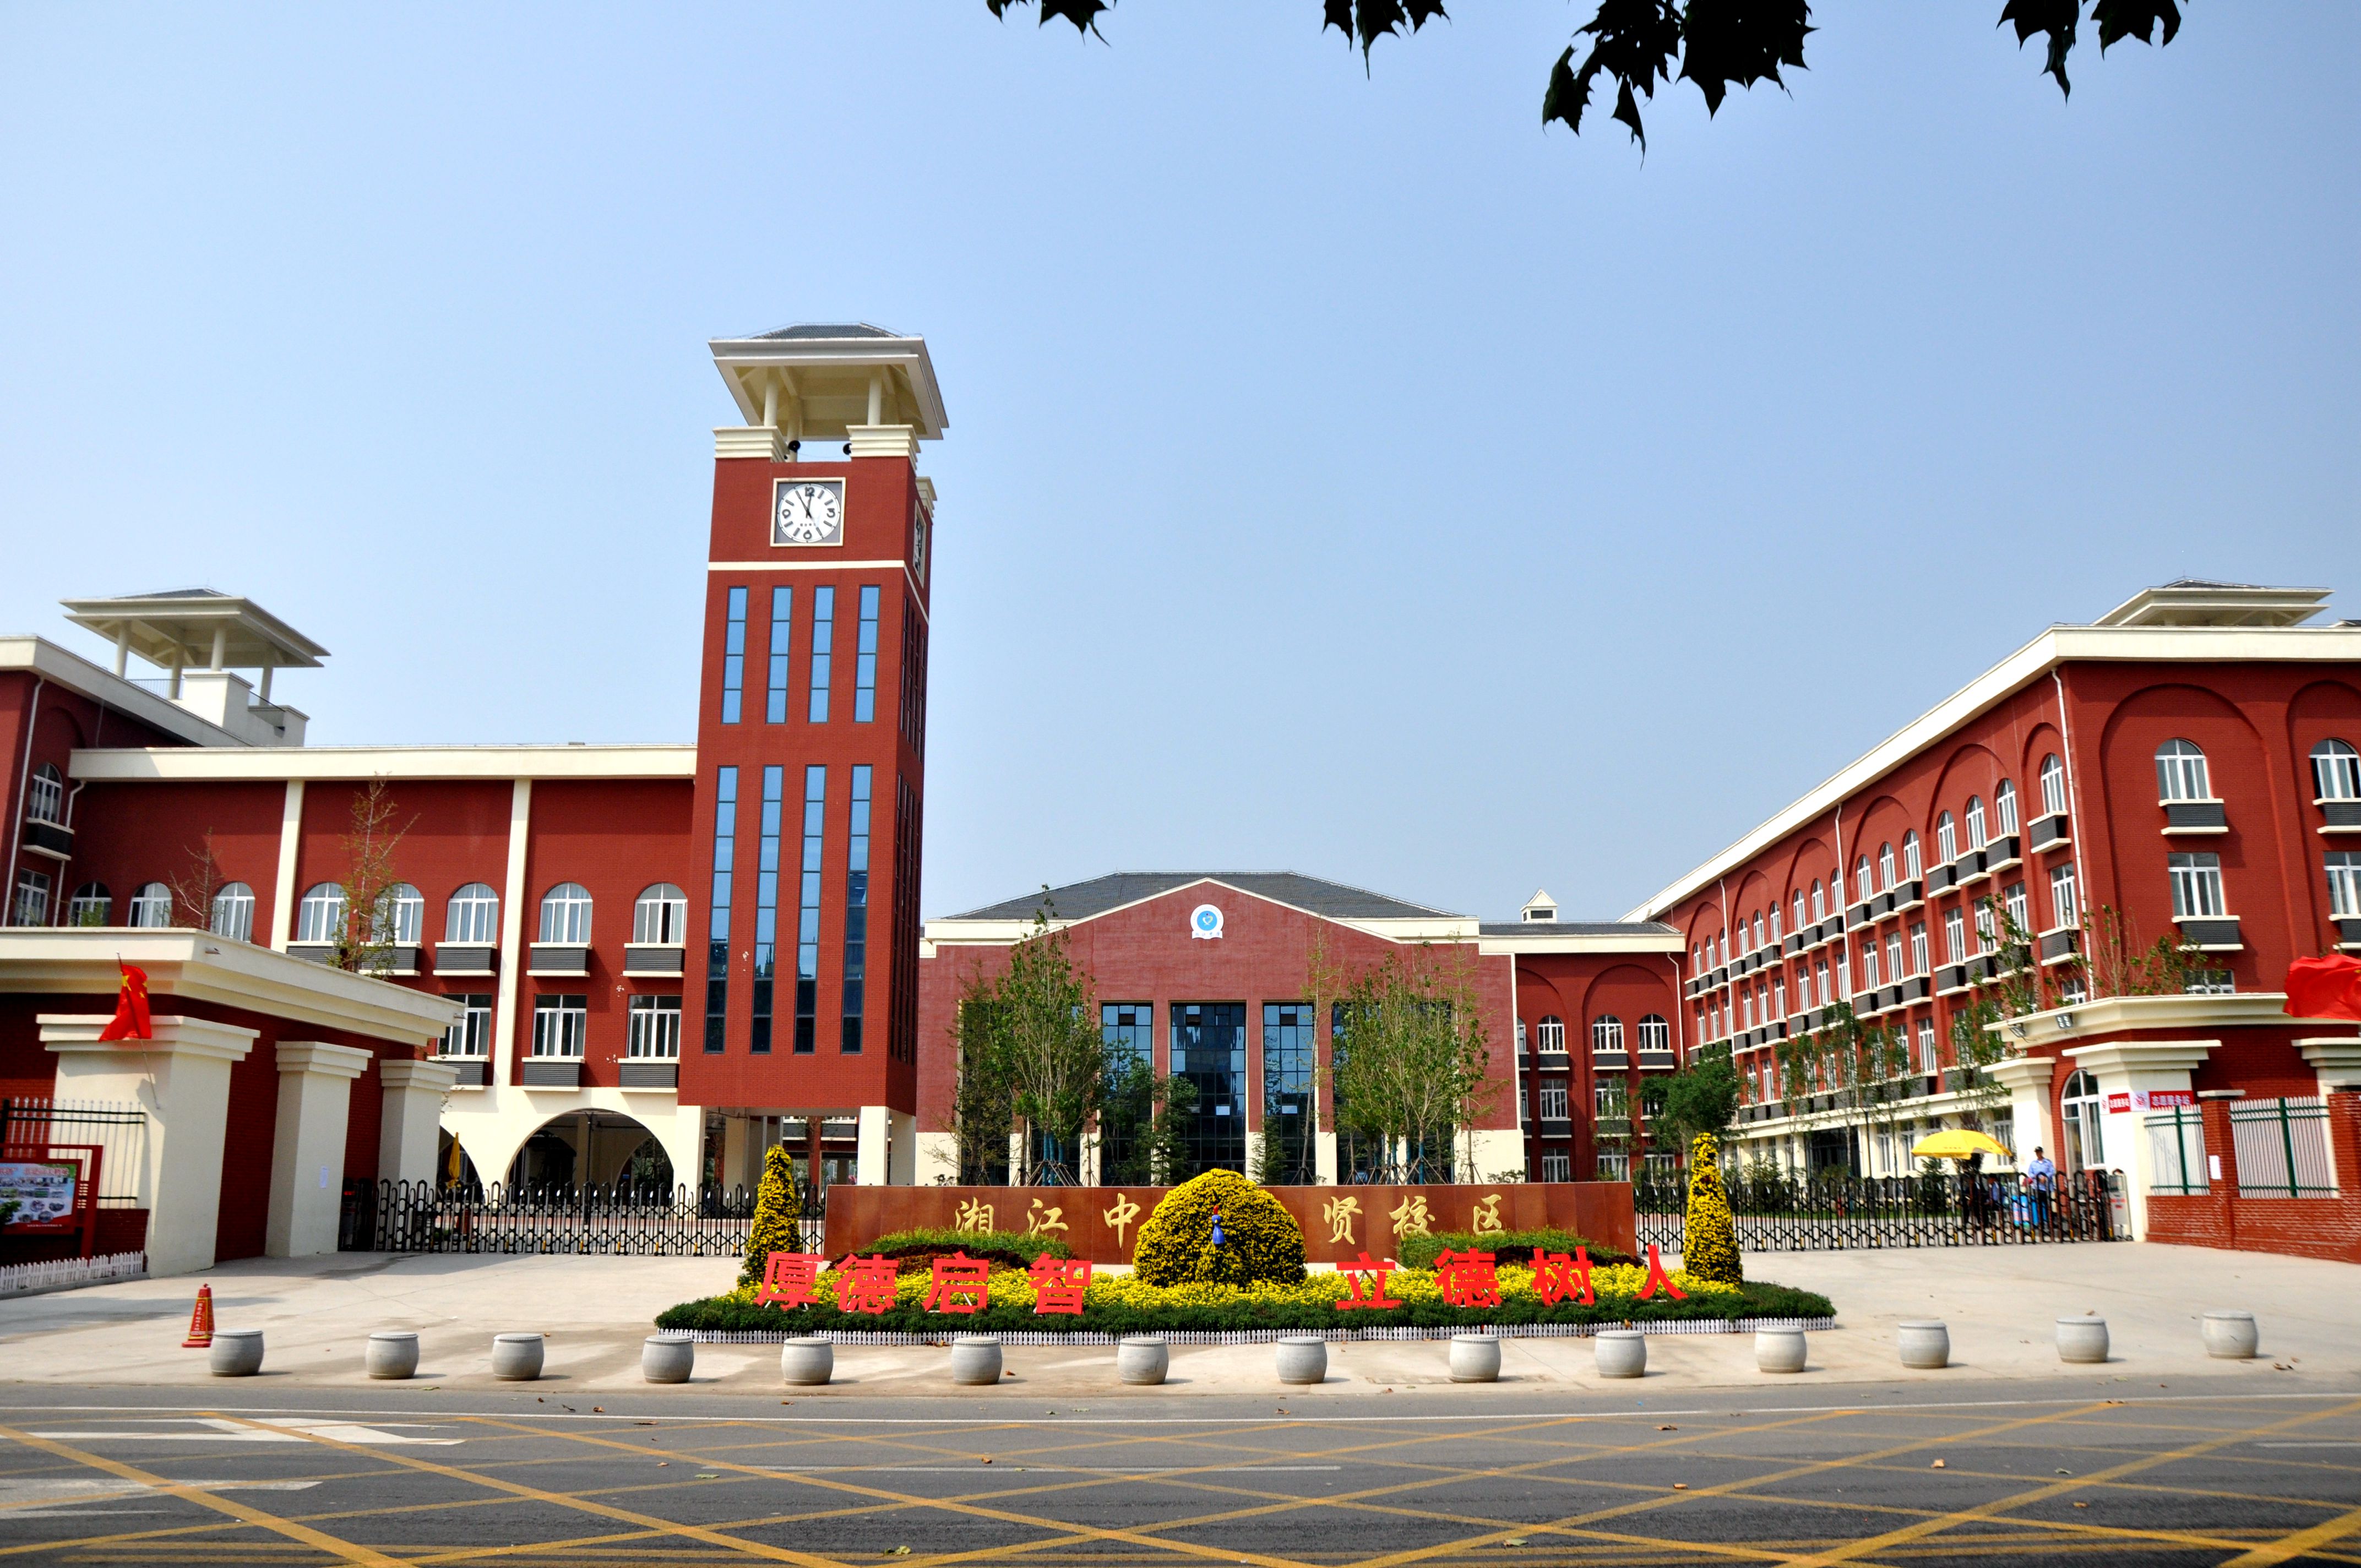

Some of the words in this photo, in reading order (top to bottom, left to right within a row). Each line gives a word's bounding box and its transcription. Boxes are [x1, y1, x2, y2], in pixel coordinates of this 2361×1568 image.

[804, 487, 815, 497] 12
[826, 508, 836, 518] 3
[803, 530, 812, 540] 6
[1336, 1245, 1689, 1309] 立德树人
[754, 1251, 1092, 1315] 厚德启智
